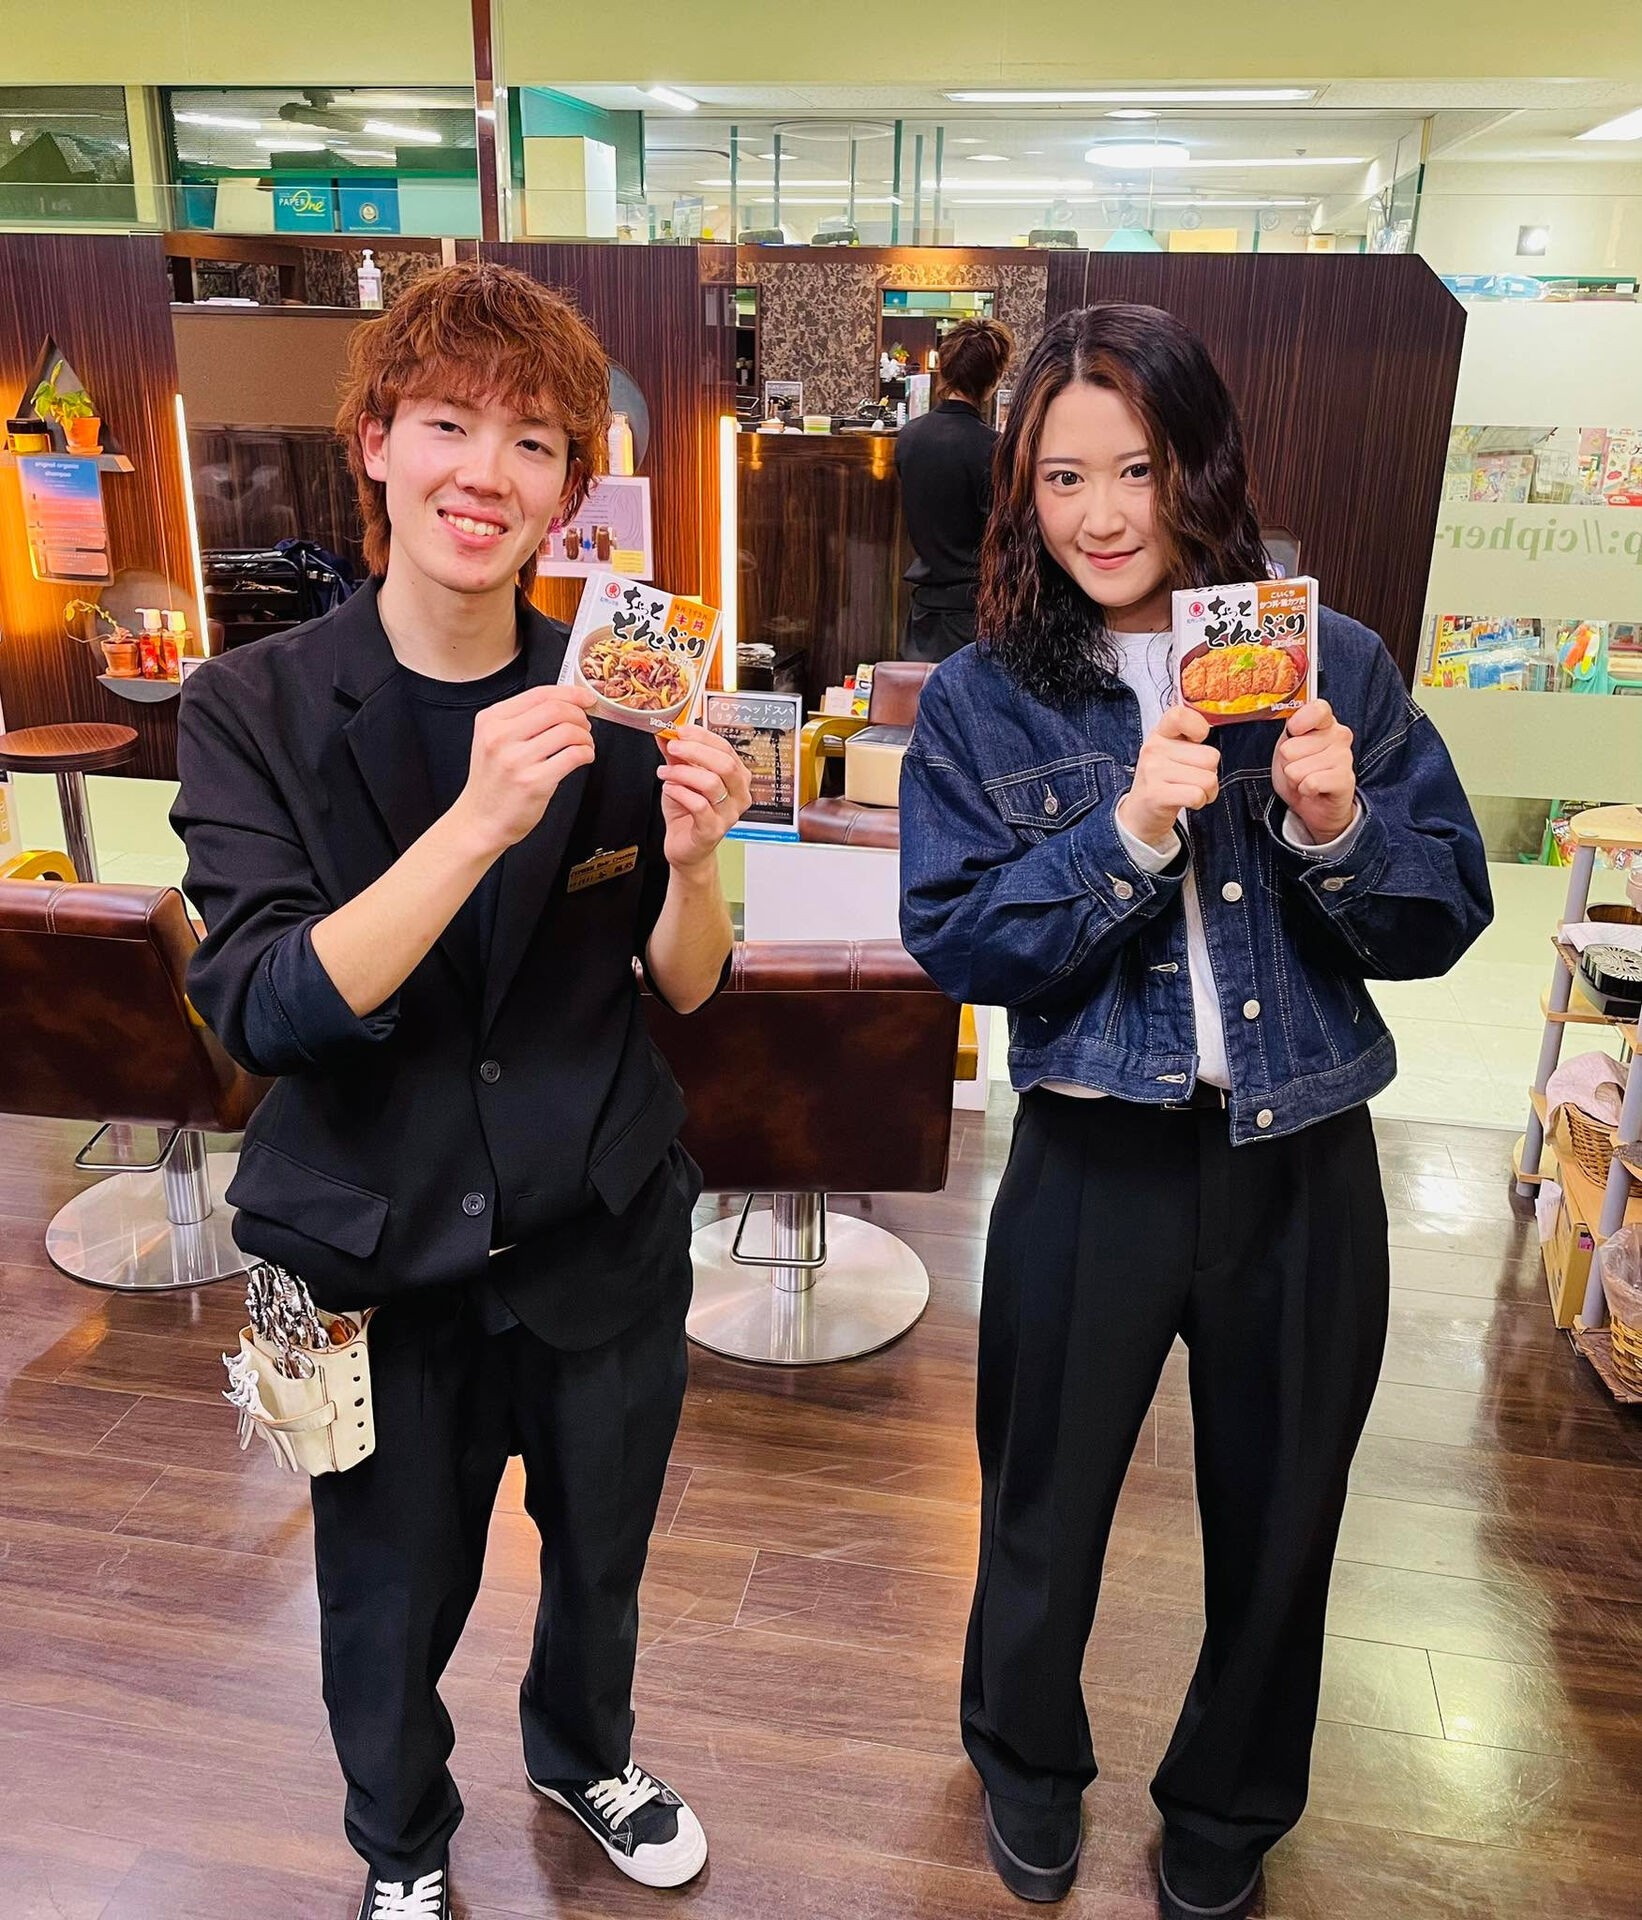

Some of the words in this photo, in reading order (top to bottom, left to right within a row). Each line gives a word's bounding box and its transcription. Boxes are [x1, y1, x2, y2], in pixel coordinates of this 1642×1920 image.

[279, 198, 305, 207] PAPER
[292, 189, 326, 213] One
[623, 586, 665, 621] ちょっと
[1207, 595, 1252, 621] ちょっと
[612, 611, 706, 659] どんぶり
[1205, 615, 1304, 648] どんぶり
